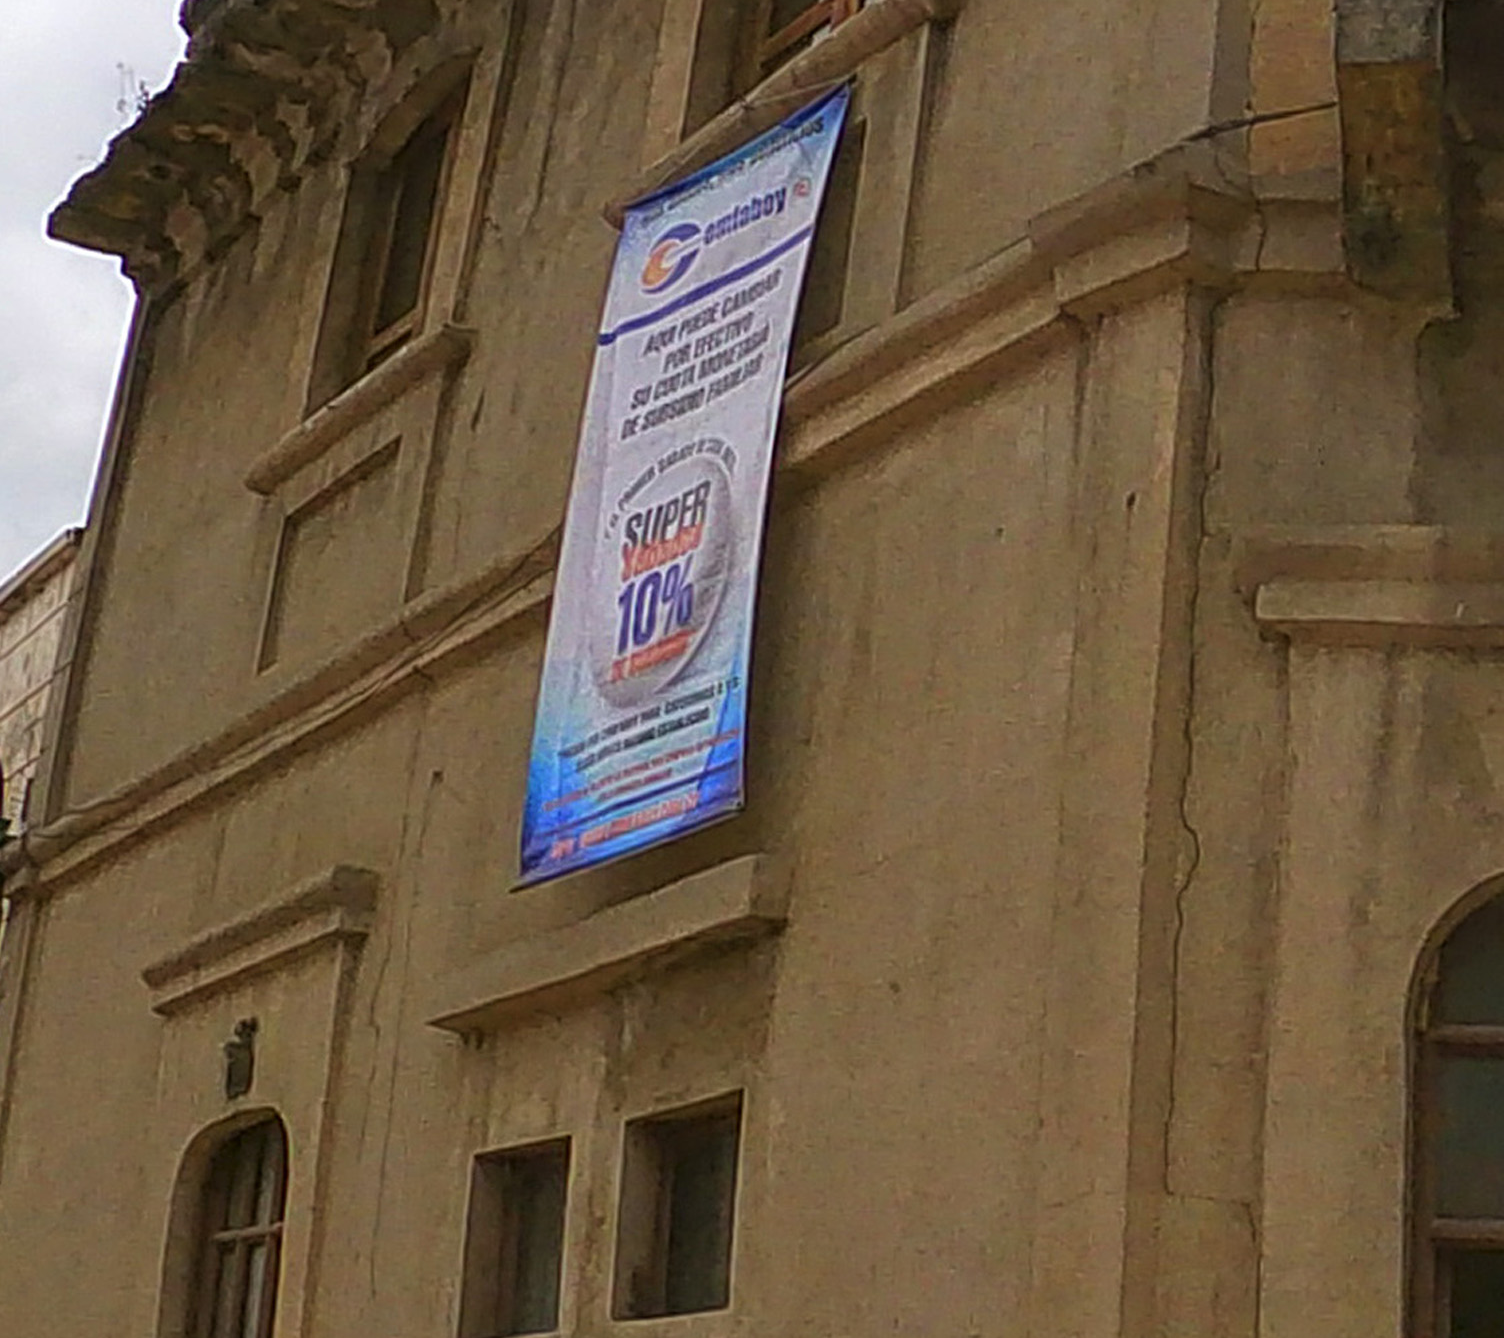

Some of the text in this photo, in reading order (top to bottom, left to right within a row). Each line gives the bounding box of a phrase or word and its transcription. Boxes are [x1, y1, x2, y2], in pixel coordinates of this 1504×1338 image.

[678, 302, 720, 339] PUEDE
[721, 268, 782, 318] CAMBIAR
[663, 311, 754, 373] POR EFECTIVO
[631, 385, 652, 410] SU
[653, 364, 696, 401] CUOTA
[621, 415, 641, 440] DE
[623, 479, 711, 551] SUPER
[618, 554, 694, 655] 10%
